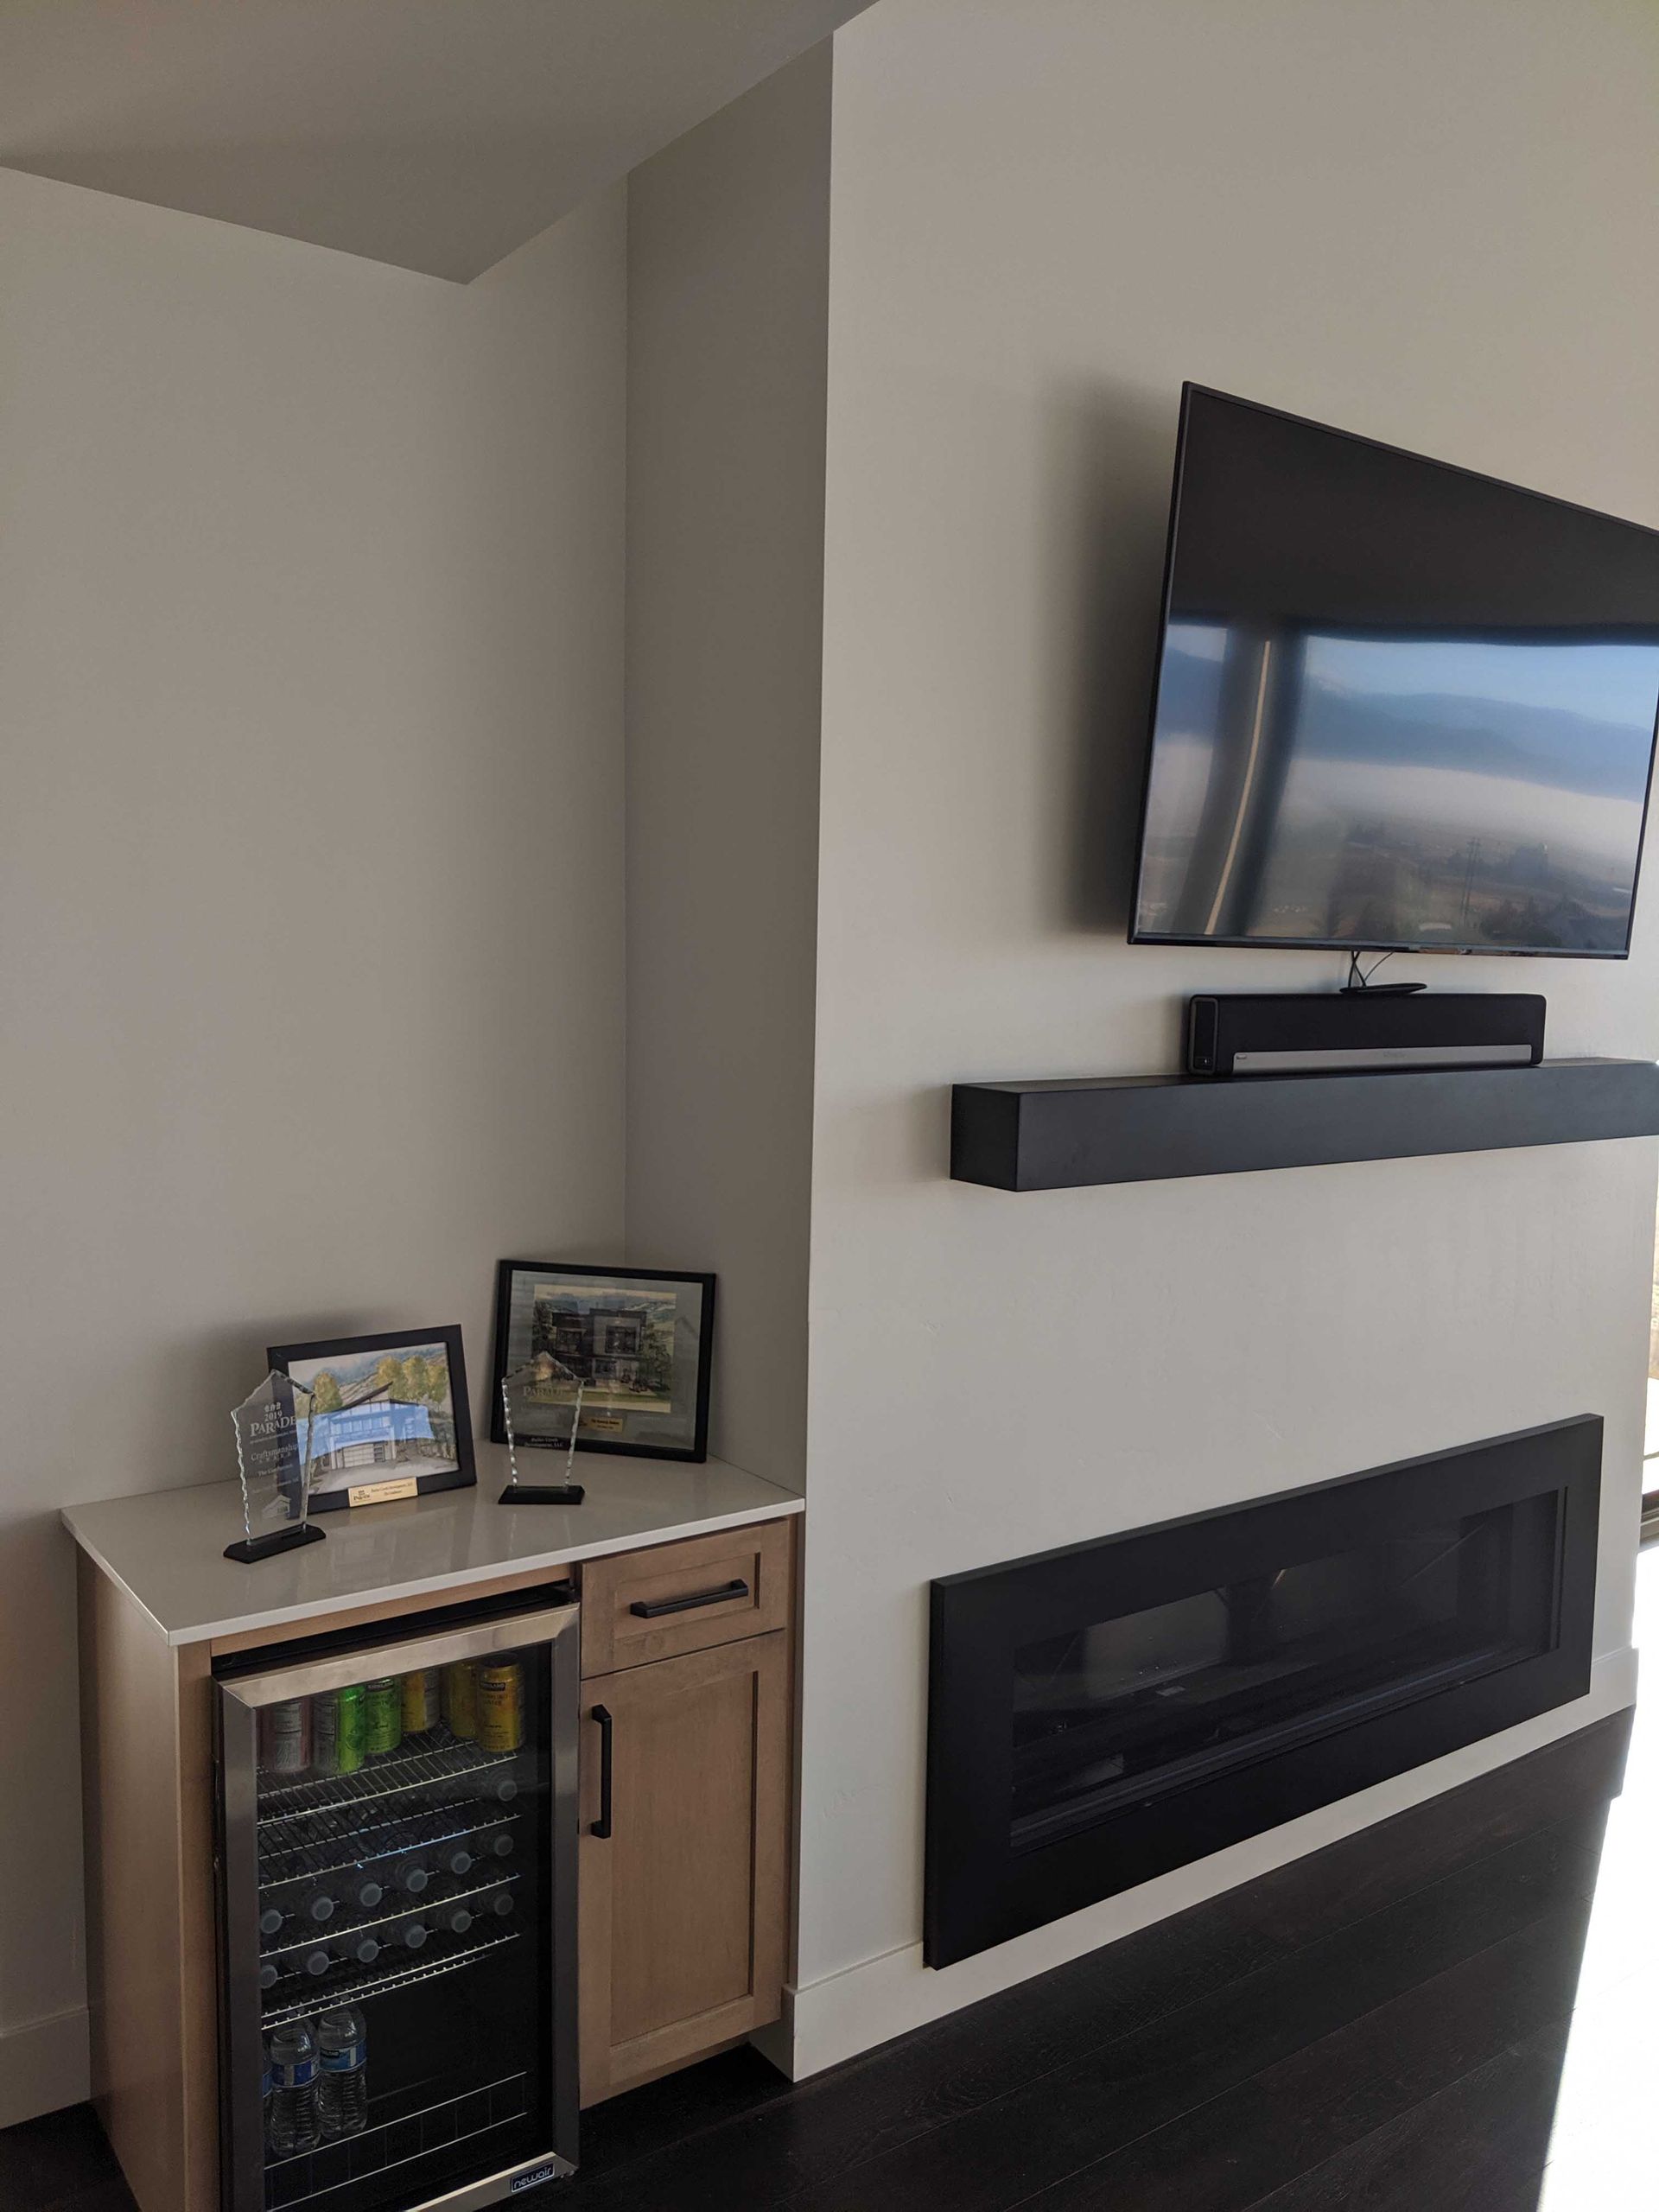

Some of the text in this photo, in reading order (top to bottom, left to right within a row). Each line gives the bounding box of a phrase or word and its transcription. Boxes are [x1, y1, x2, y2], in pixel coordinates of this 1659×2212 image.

[250, 1416, 296, 1437] PARADE
[264, 1410, 283, 1422] 2019
[513, 2165, 552, 2190] newair
